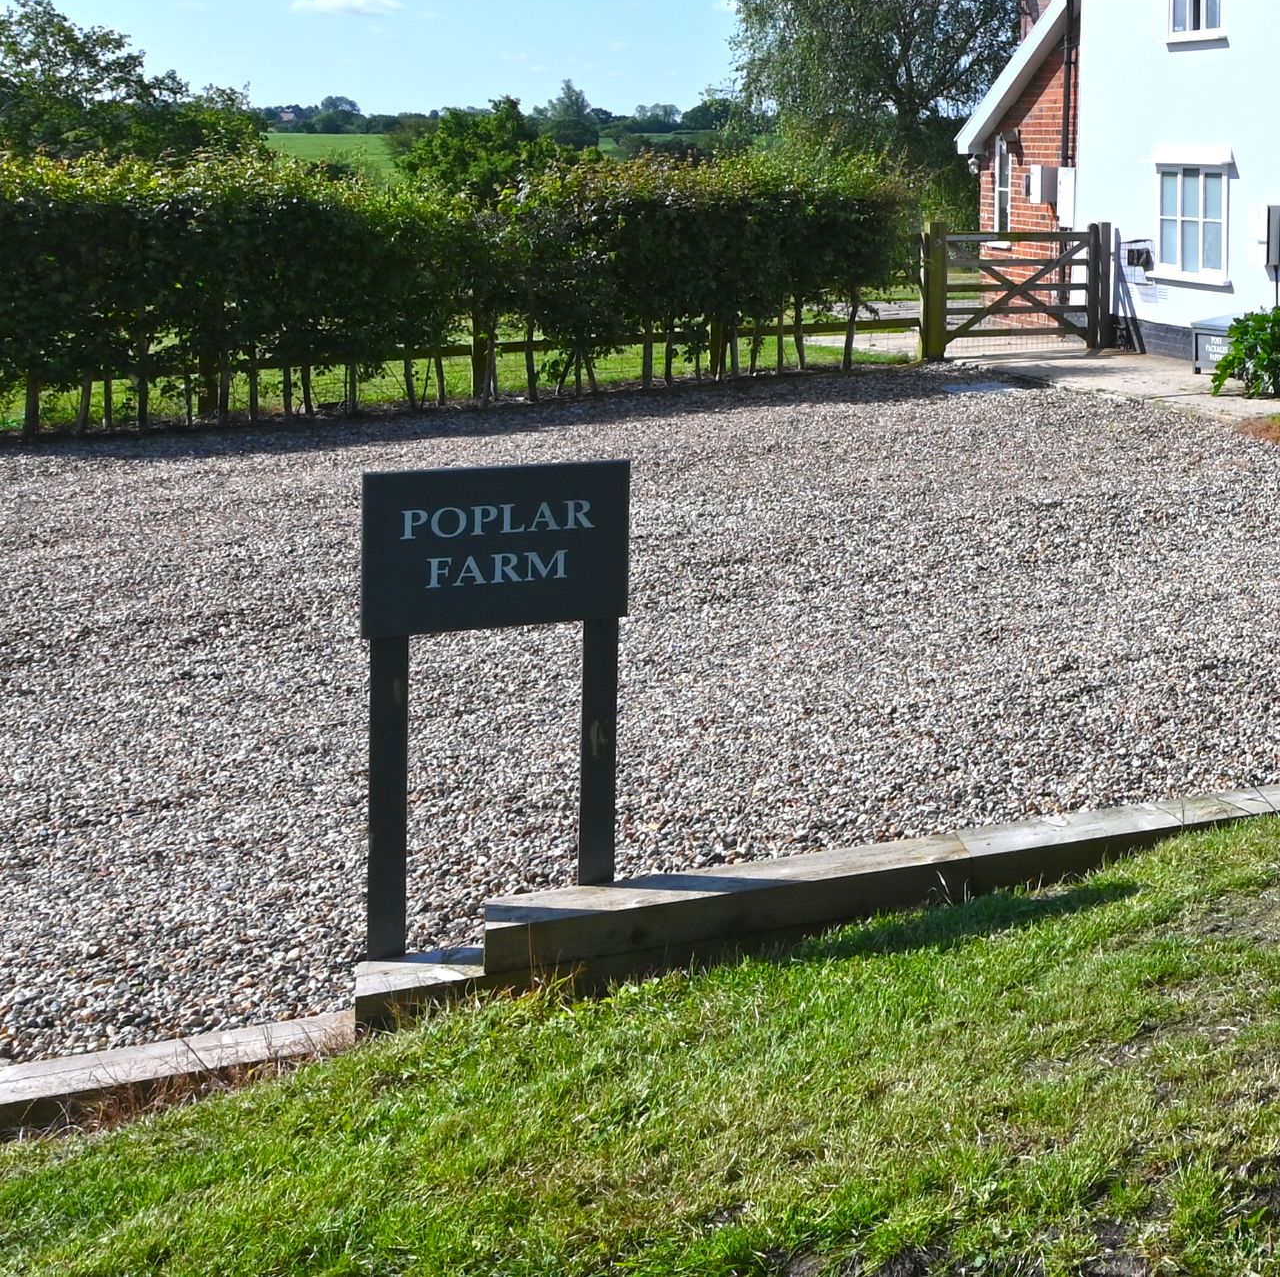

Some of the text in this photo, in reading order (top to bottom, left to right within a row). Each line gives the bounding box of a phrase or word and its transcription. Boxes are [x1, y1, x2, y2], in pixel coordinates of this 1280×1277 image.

[1210, 336, 1222, 344] POST
[400, 499, 596, 540] POPLAR
[425, 549, 569, 589] FARM
